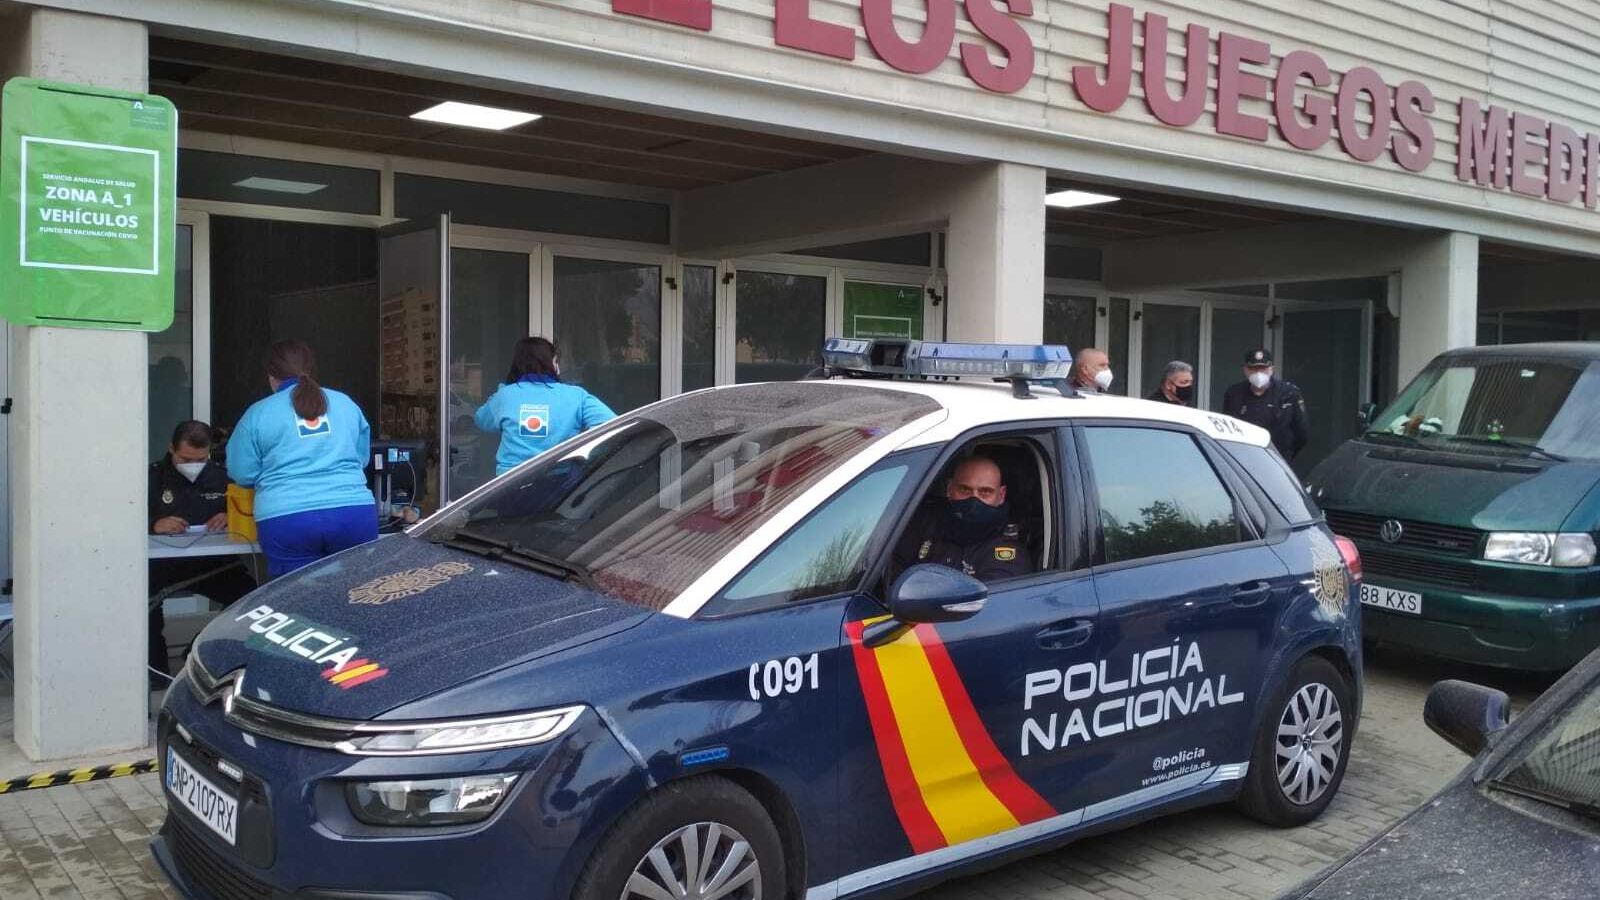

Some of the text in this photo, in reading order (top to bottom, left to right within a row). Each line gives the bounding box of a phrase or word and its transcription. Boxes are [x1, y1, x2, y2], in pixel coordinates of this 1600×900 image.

[1072, 4, 1435, 173] JUEGOS
[39, 207, 138, 229] VEHÍCULOS
[45, 185, 132, 208] ZONA A_1
[1386, 590, 1417, 611] KXS
[234, 604, 359, 673] POLICÍA
[763, 653, 819, 698] 091
[1024, 636, 1204, 711] POLICÍA
[1021, 674, 1245, 757] NACIONAL
